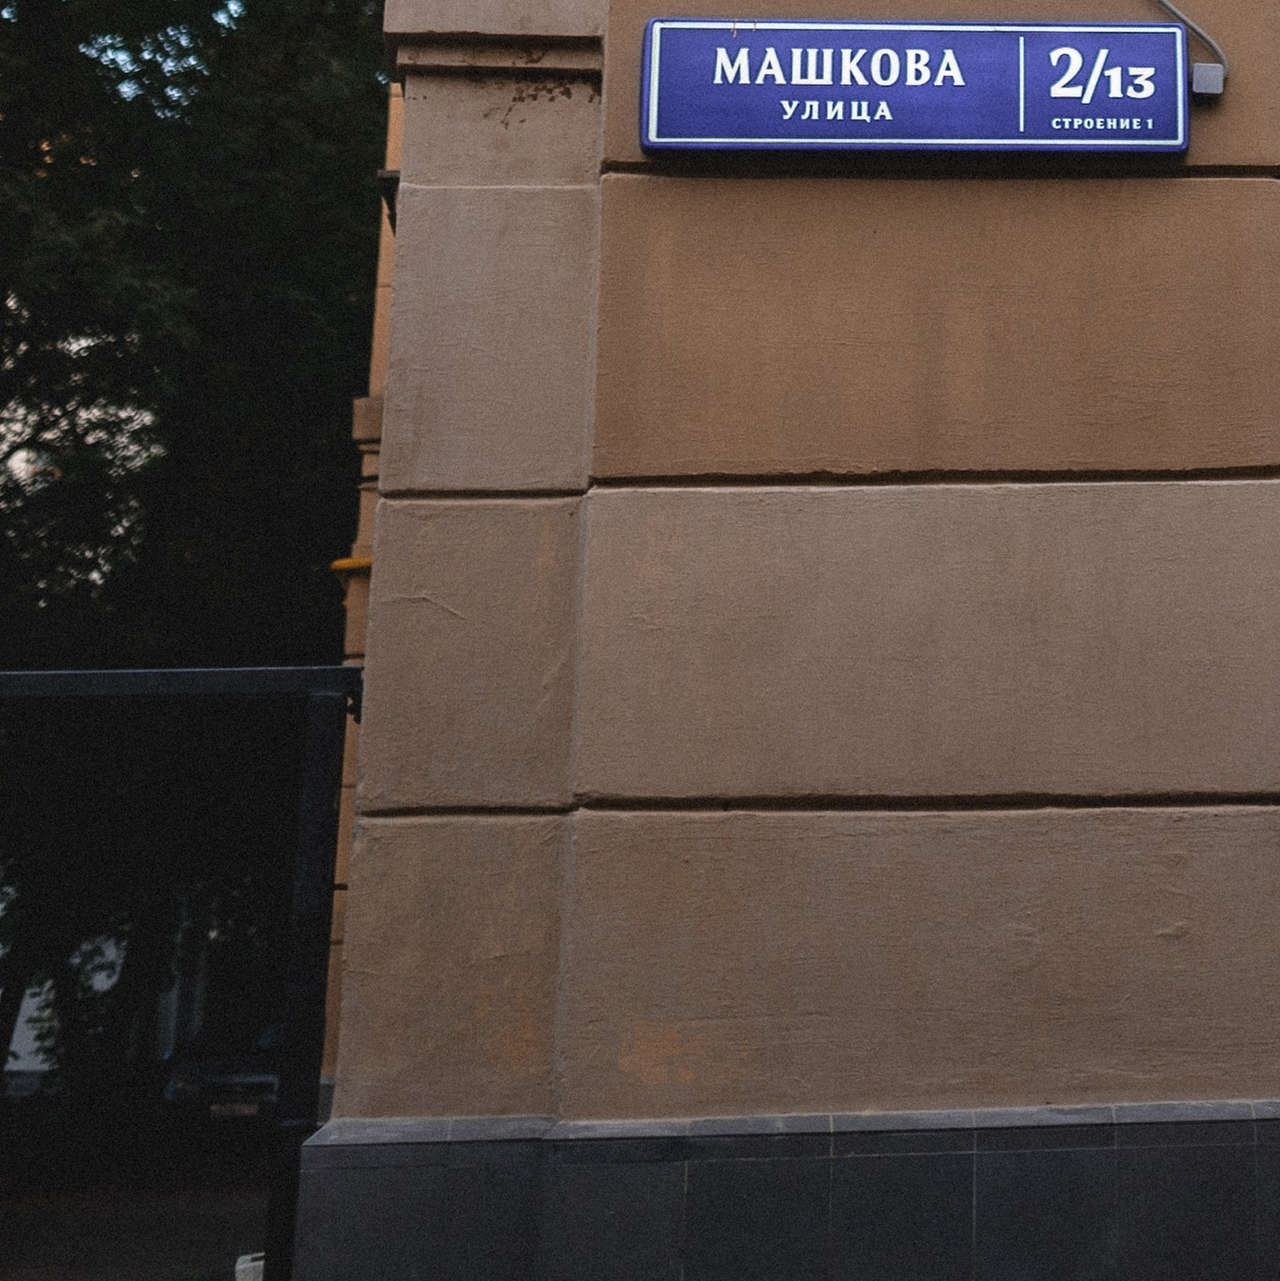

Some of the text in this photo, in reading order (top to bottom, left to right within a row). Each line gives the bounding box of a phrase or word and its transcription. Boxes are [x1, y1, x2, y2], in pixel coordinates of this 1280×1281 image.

[713, 47, 966, 86] МАШКОВА
[1049, 46, 1156, 104] 2/13
[780, 100, 893, 123] УЛИЦА
[1051, 117, 1154, 130] СТРОЕНИЕ 1
